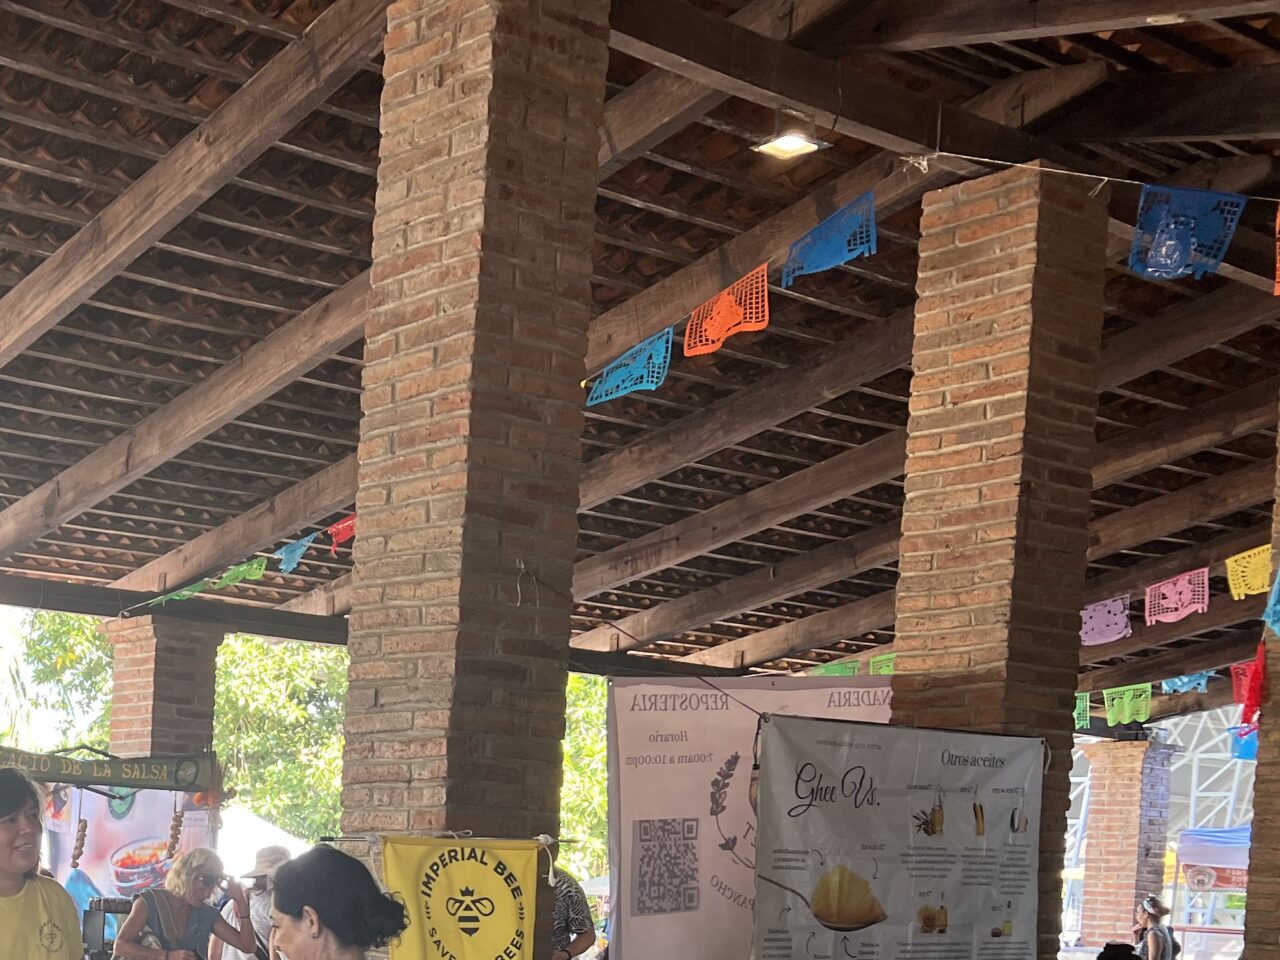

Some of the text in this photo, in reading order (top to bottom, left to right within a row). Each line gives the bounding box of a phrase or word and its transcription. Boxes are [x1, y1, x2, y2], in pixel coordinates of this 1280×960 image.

[60, 759, 82, 776] DE
[92, 761, 111, 778] LA
[121, 763, 169, 780] SALSA
[941, 749, 1007, 769] Otros aceites
[787, 762, 837, 817] Ghee
[421, 847, 523, 900] IMPERIAL BEE
